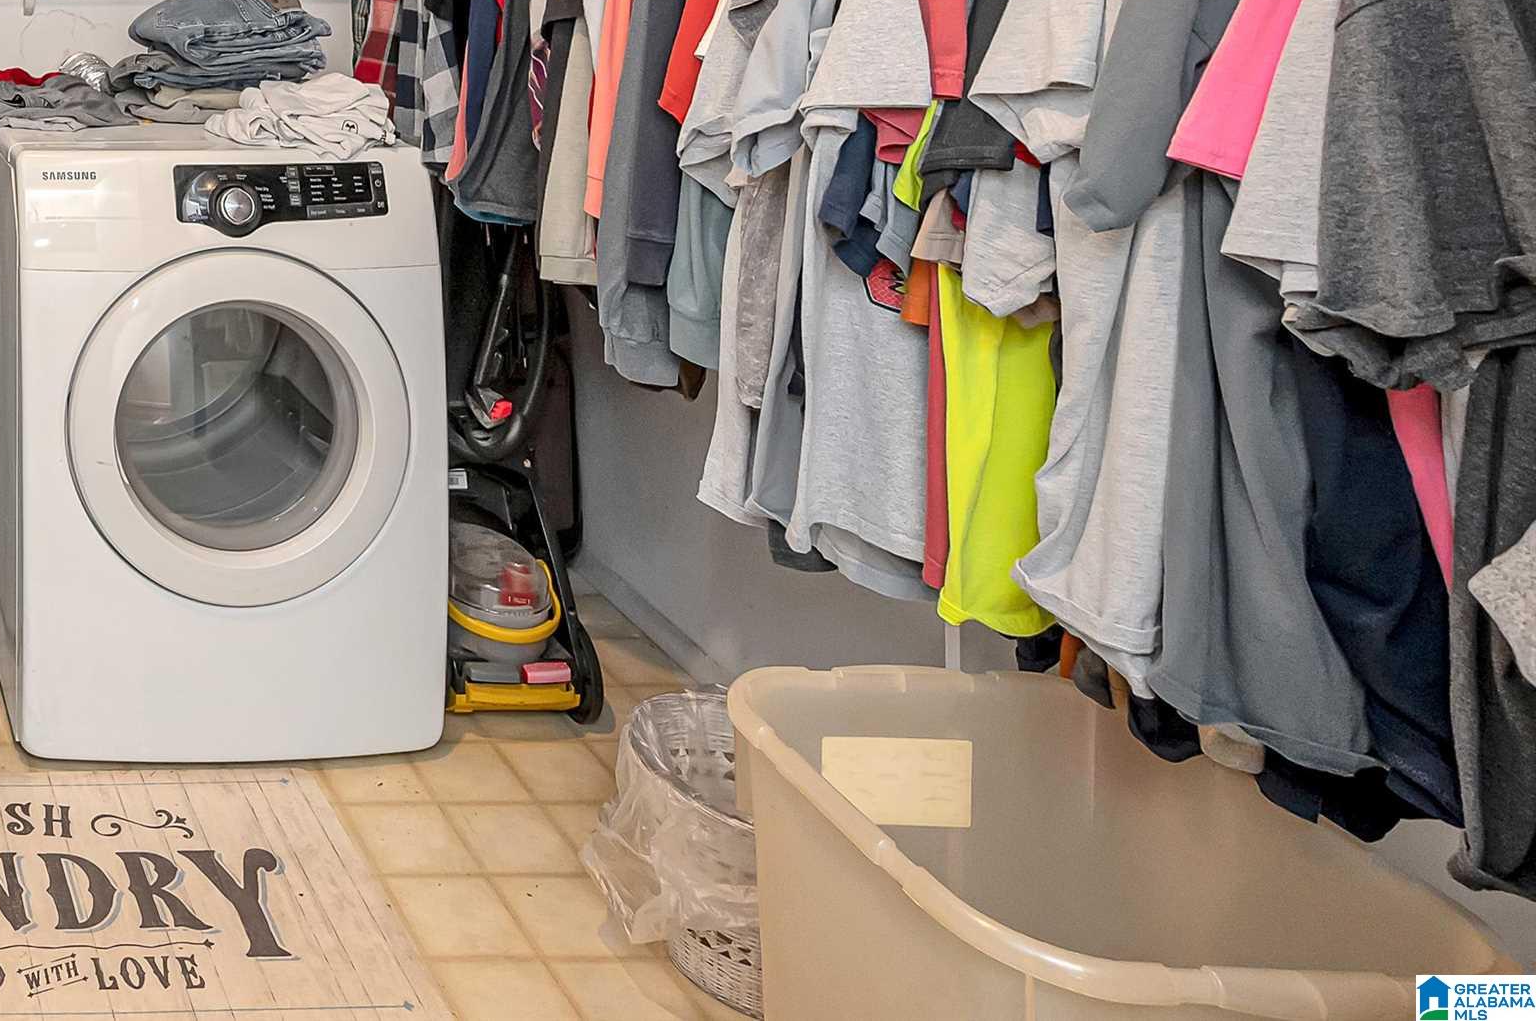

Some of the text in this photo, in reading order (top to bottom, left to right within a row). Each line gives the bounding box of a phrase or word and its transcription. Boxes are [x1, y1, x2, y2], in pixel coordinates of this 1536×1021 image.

[41, 171, 97, 181] SAMSUNG
[24, 959, 80, 991] WITH
[90, 954, 206, 991] LOVE
